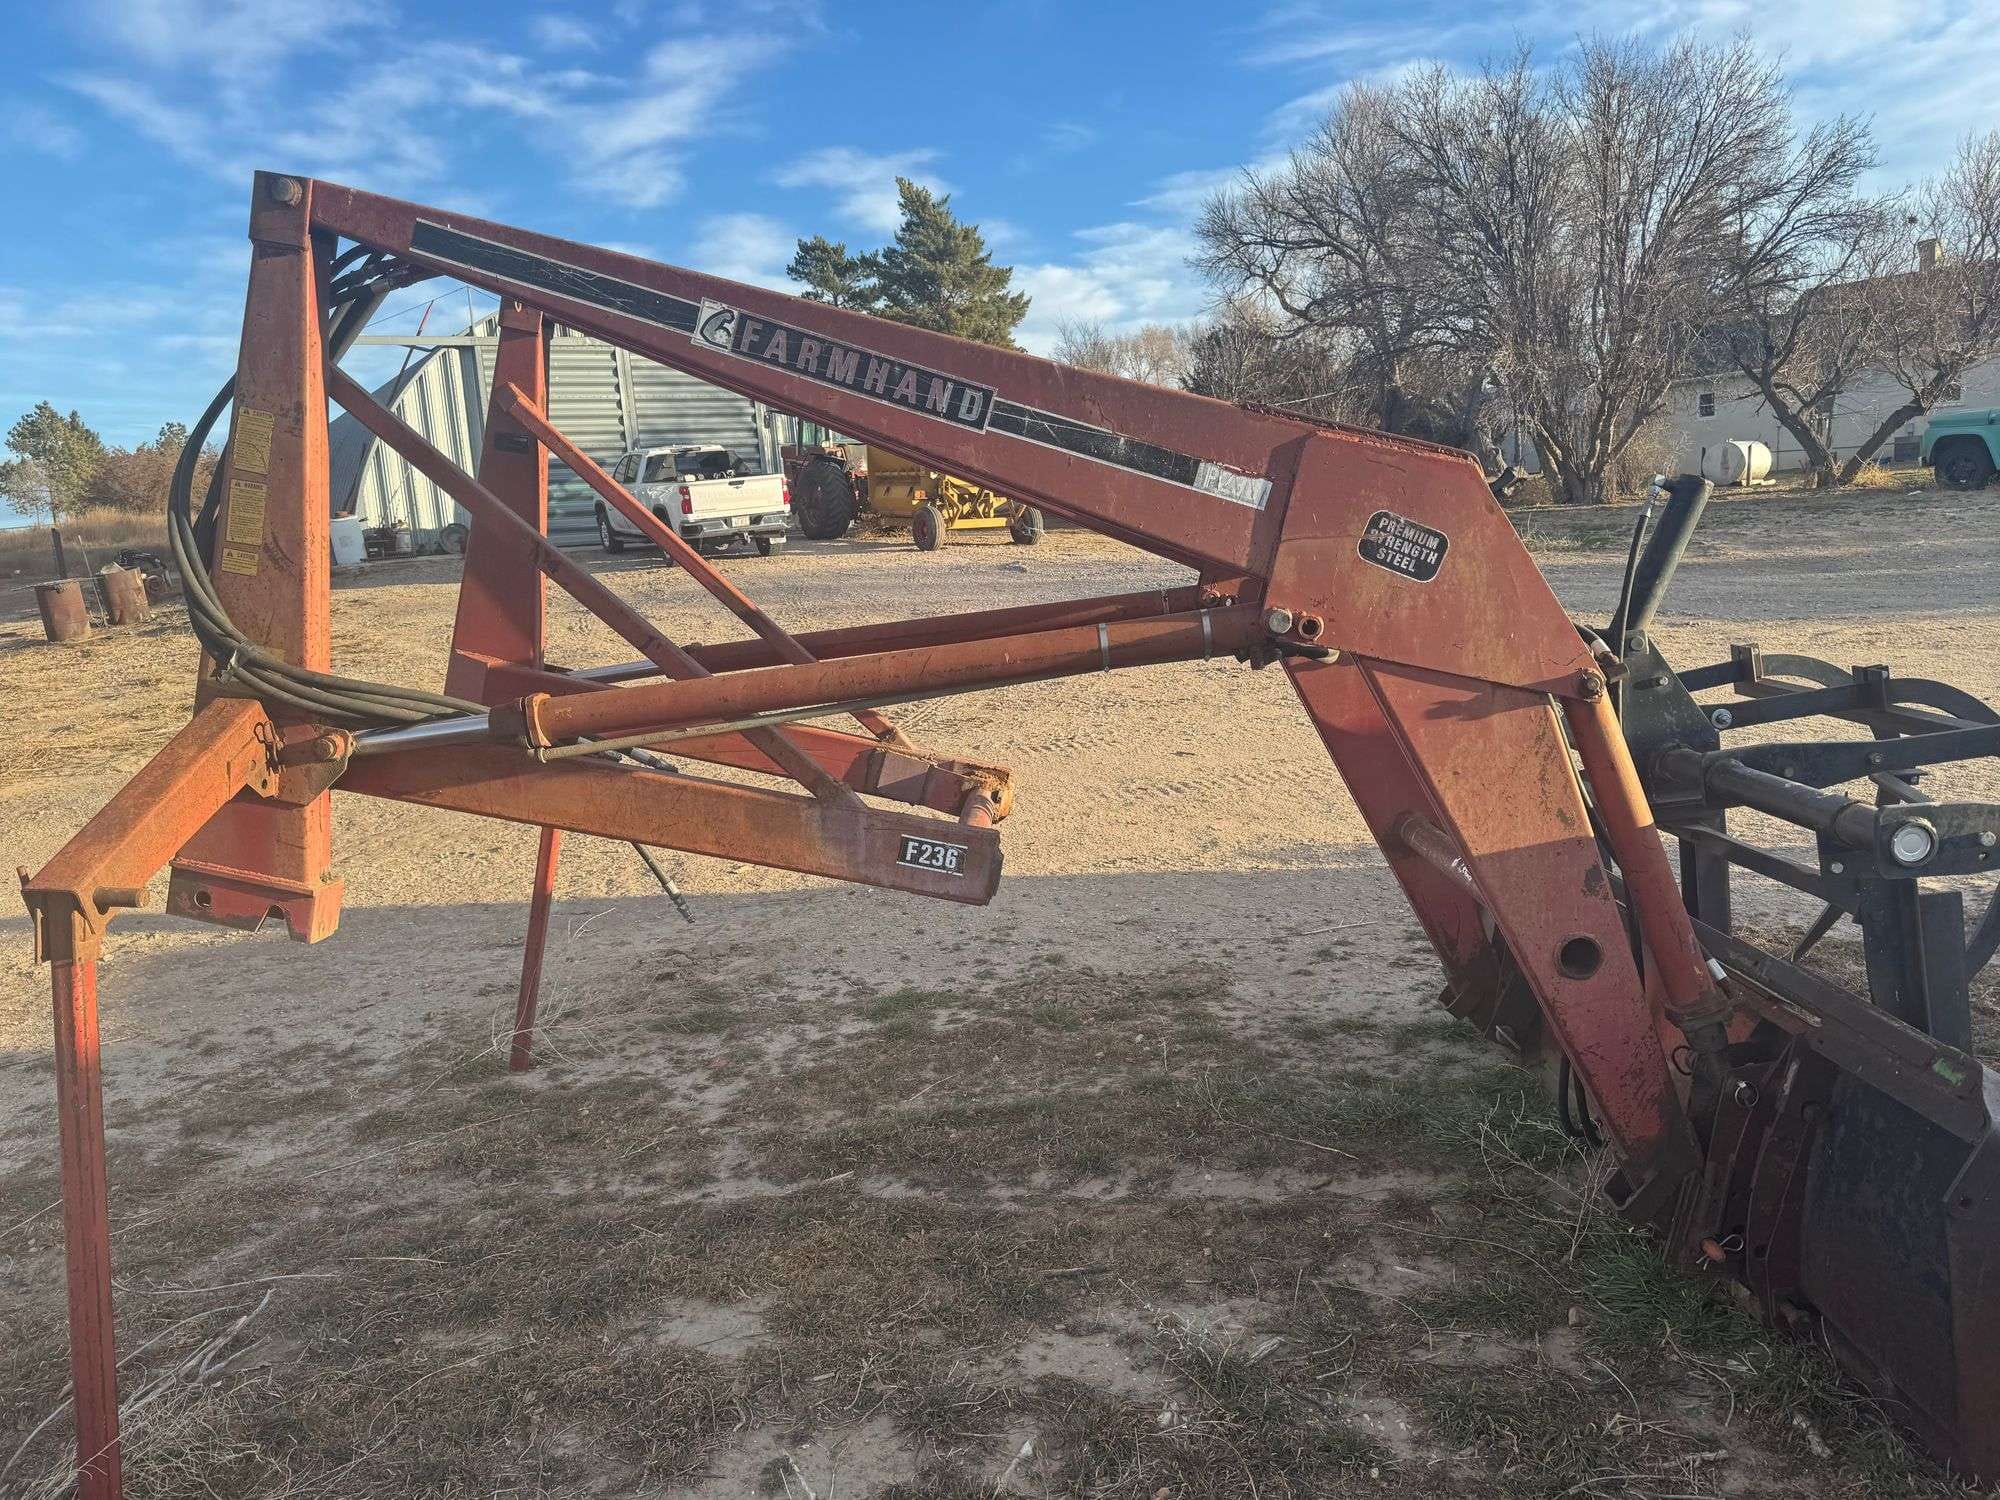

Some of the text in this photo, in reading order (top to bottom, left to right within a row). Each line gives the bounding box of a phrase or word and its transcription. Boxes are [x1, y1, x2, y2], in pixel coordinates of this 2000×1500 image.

[739, 318, 984, 422] FARMHAND
[1368, 528, 1439, 565] STRENGTH
[1378, 517, 1441, 550] PREMIUM
[1376, 547, 1416, 573] STEEL
[905, 841, 958, 869] F236
